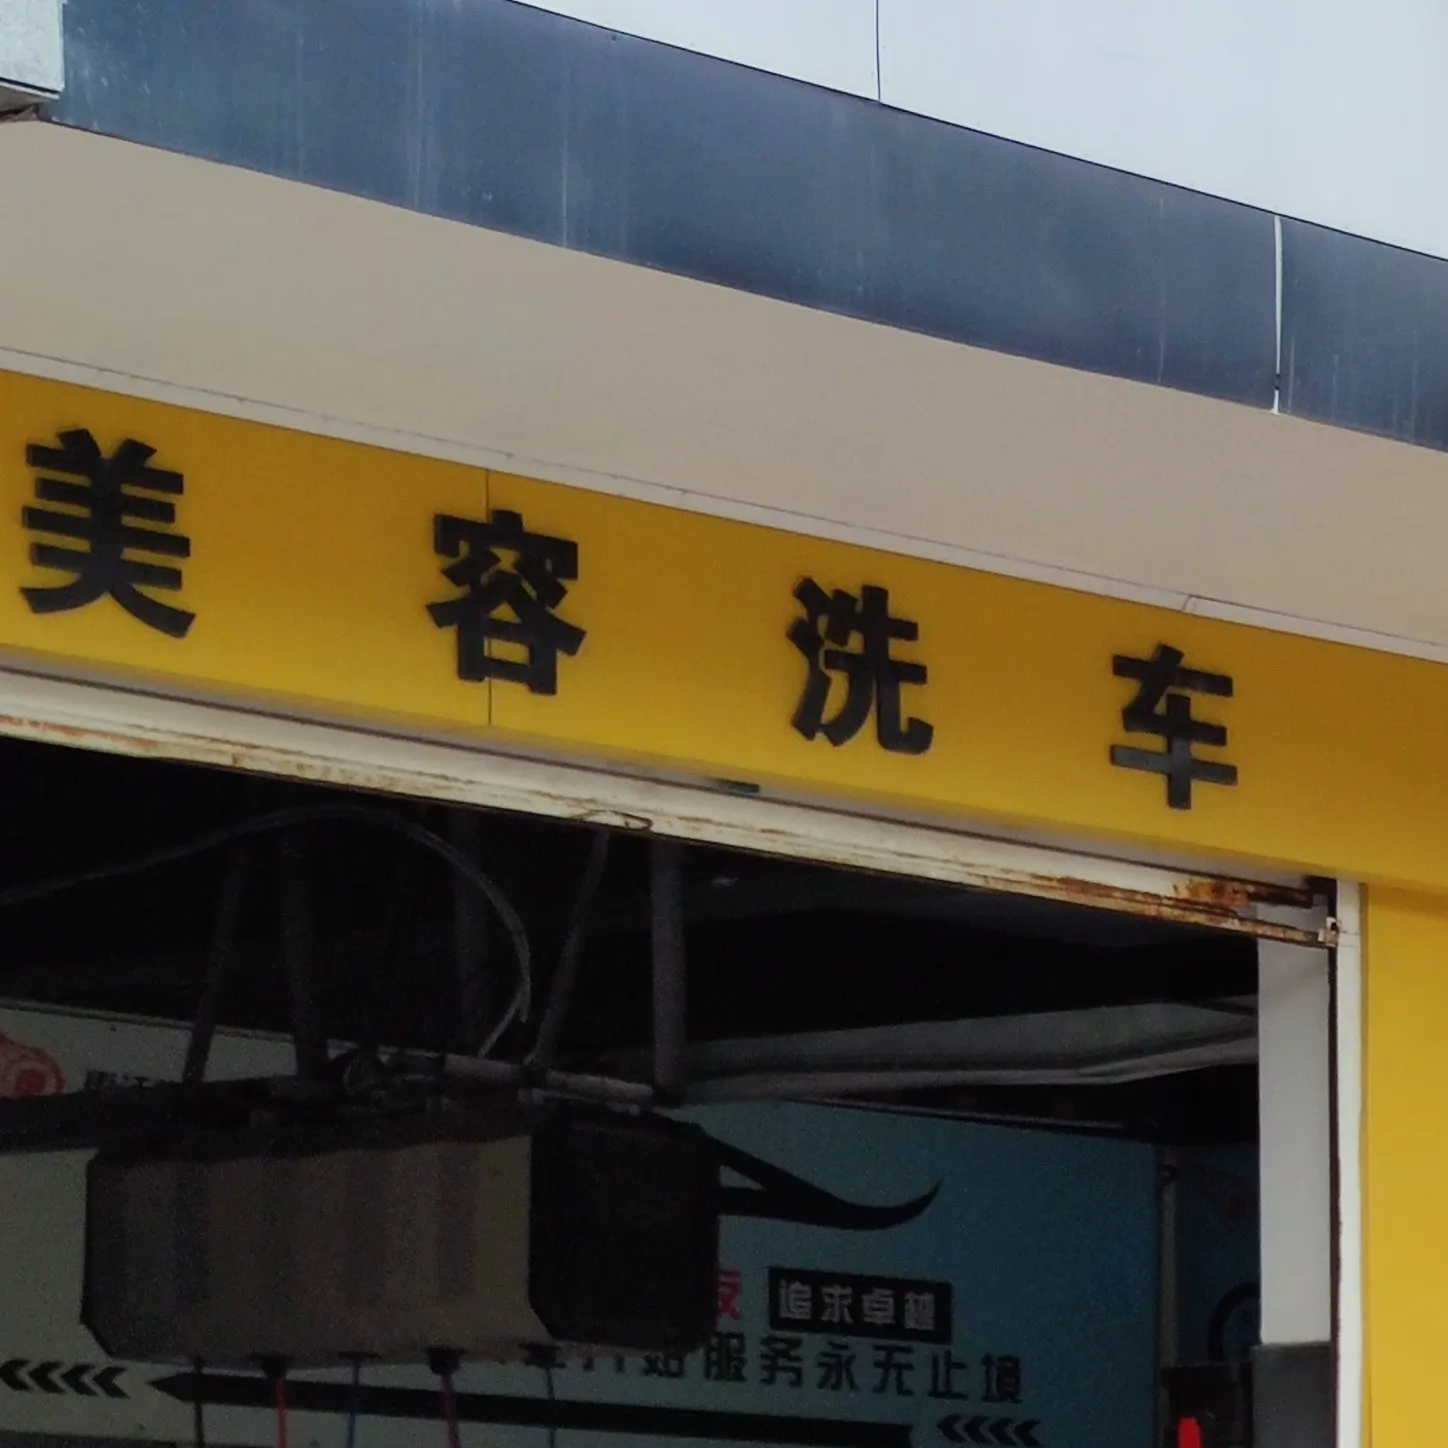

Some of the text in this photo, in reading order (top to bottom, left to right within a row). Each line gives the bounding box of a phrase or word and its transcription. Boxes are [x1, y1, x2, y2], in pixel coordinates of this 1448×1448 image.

[18, 428, 1239, 811] 美容洗车
[778, 1279, 937, 1332] 追求卓越
